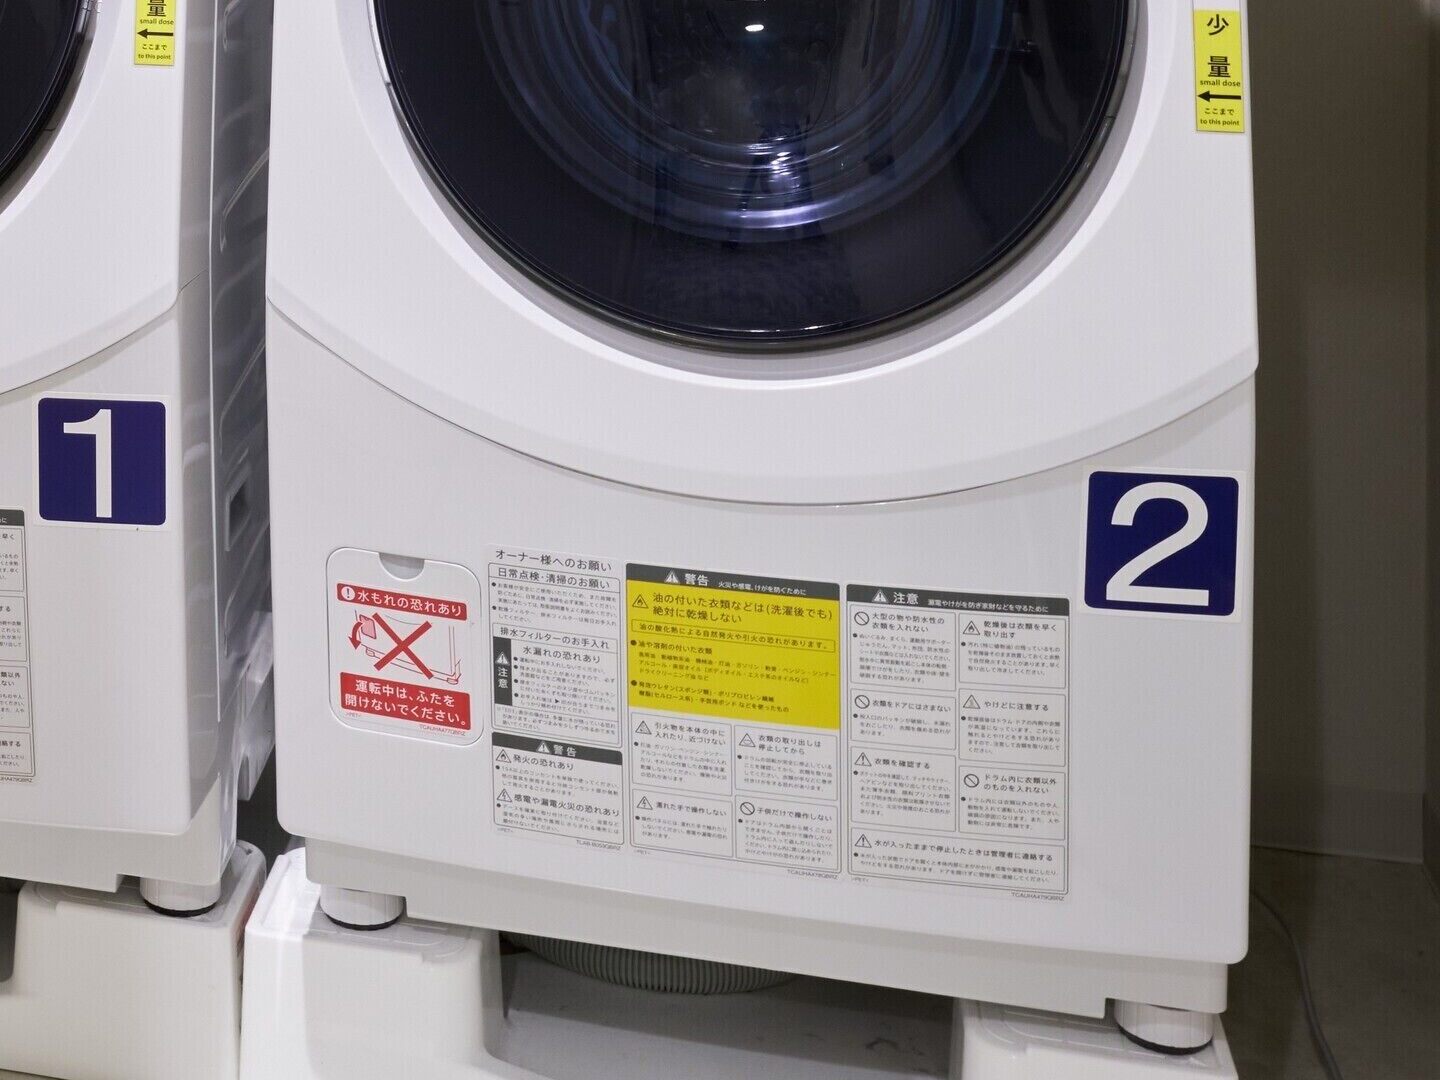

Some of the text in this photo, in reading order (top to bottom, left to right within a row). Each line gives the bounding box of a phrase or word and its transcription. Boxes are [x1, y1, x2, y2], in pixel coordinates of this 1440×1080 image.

[158, 18, 175, 26] dose
[1200, 79, 1221, 87] small
[1204, 107, 1235, 116] ここまで
[1208, 118, 1221, 126] this
[63, 408, 112, 518] 1
[1105, 481, 1210, 607] 2
[495, 549, 612, 572] オーナー様へのお願い
[685, 572, 709, 588] 警告
[357, 590, 462, 617] 水もれの恐れあり
[893, 591, 919, 606] 注意
[652, 606, 742, 624] 絶対に乾燥しない
[355, 678, 455, 708] 運転中は、ふたを
[344, 693, 467, 727] 開けないでください。
